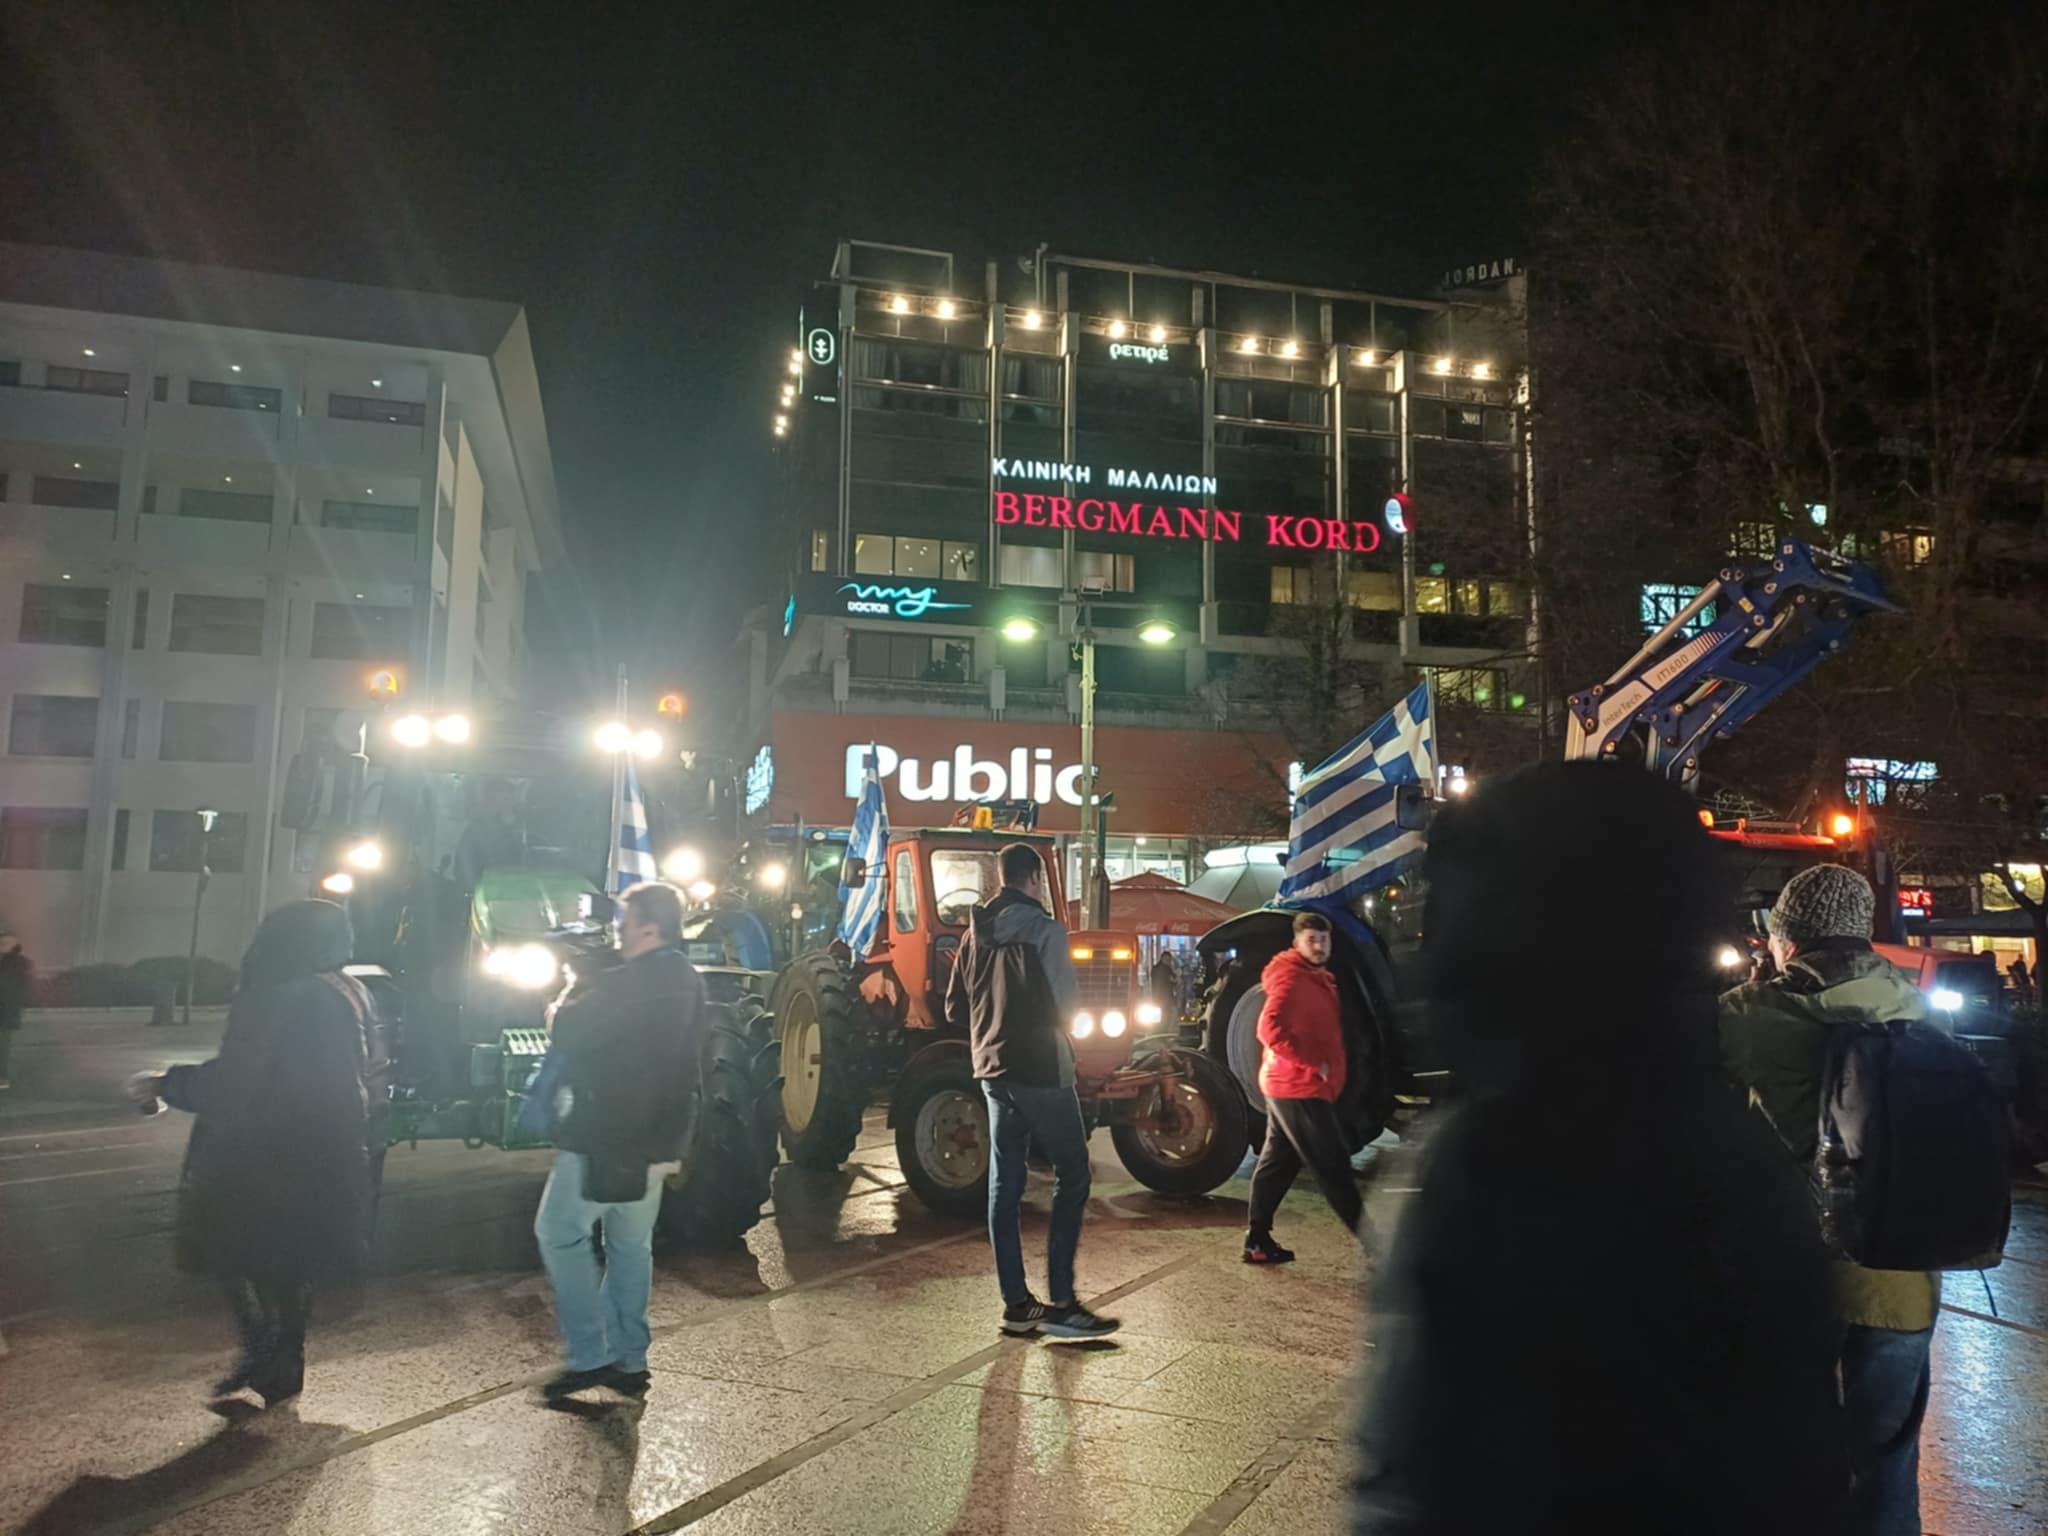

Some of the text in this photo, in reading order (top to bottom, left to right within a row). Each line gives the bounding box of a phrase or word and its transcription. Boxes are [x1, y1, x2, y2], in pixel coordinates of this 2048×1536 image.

[993, 457, 1217, 494] ΚΛΙΝΙΚΗ ΜΑΛΛΙΩΝ
[994, 491, 1380, 552] BERGMANN KORD
[847, 601, 889, 614] DOCTOR
[845, 744, 1100, 806] Public
